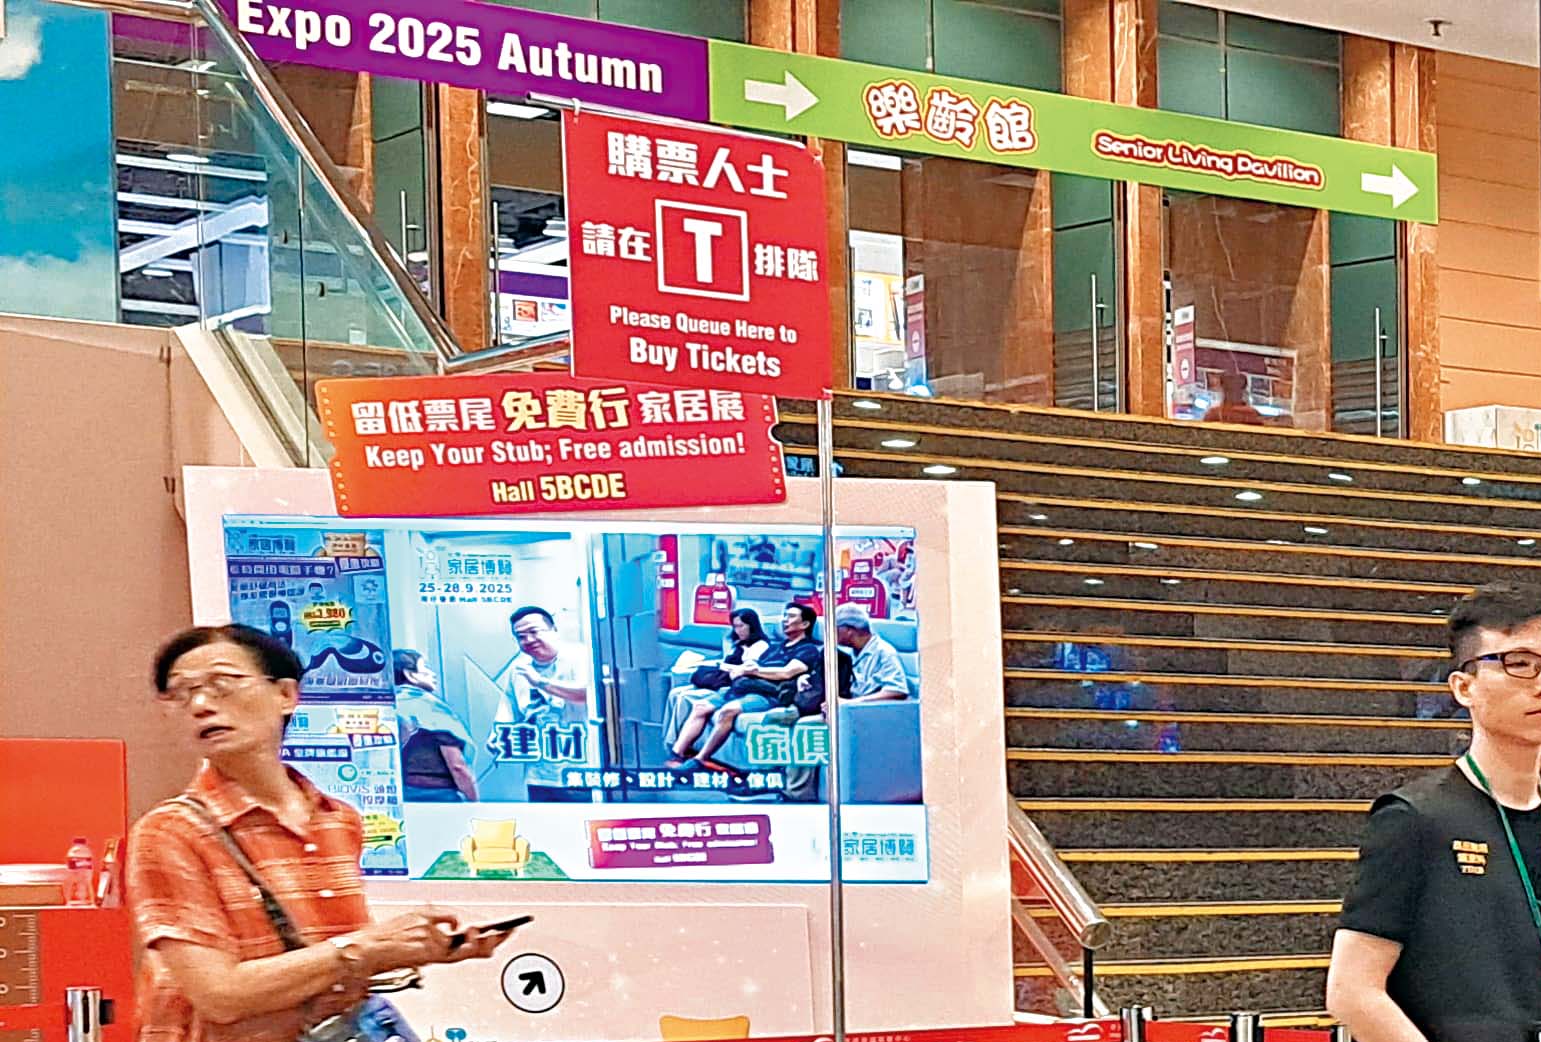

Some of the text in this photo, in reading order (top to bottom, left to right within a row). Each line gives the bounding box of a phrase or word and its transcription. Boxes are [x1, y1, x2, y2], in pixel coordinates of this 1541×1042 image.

[238, 0, 664, 94] Expo 2025 Autumn
[866, 83, 1035, 152] 樂齡館
[607, 131, 789, 199] 購票人士
[1097, 135, 1166, 162] Senior
[1167, 145, 1234, 174] Living
[581, 221, 652, 262] 請在
[683, 218, 722, 283] T
[754, 243, 819, 282] 排隊
[609, 305, 797, 343] Please Queue Here to
[629, 336, 782, 377] Buy Tickets
[351, 388, 746, 435] 留低票尾 免費行 家居展
[365, 432, 746, 471] Keep Your Stub; Free admission!
[492, 474, 626, 504] Hall 5BCDE
[495, 724, 586, 761] 建材
